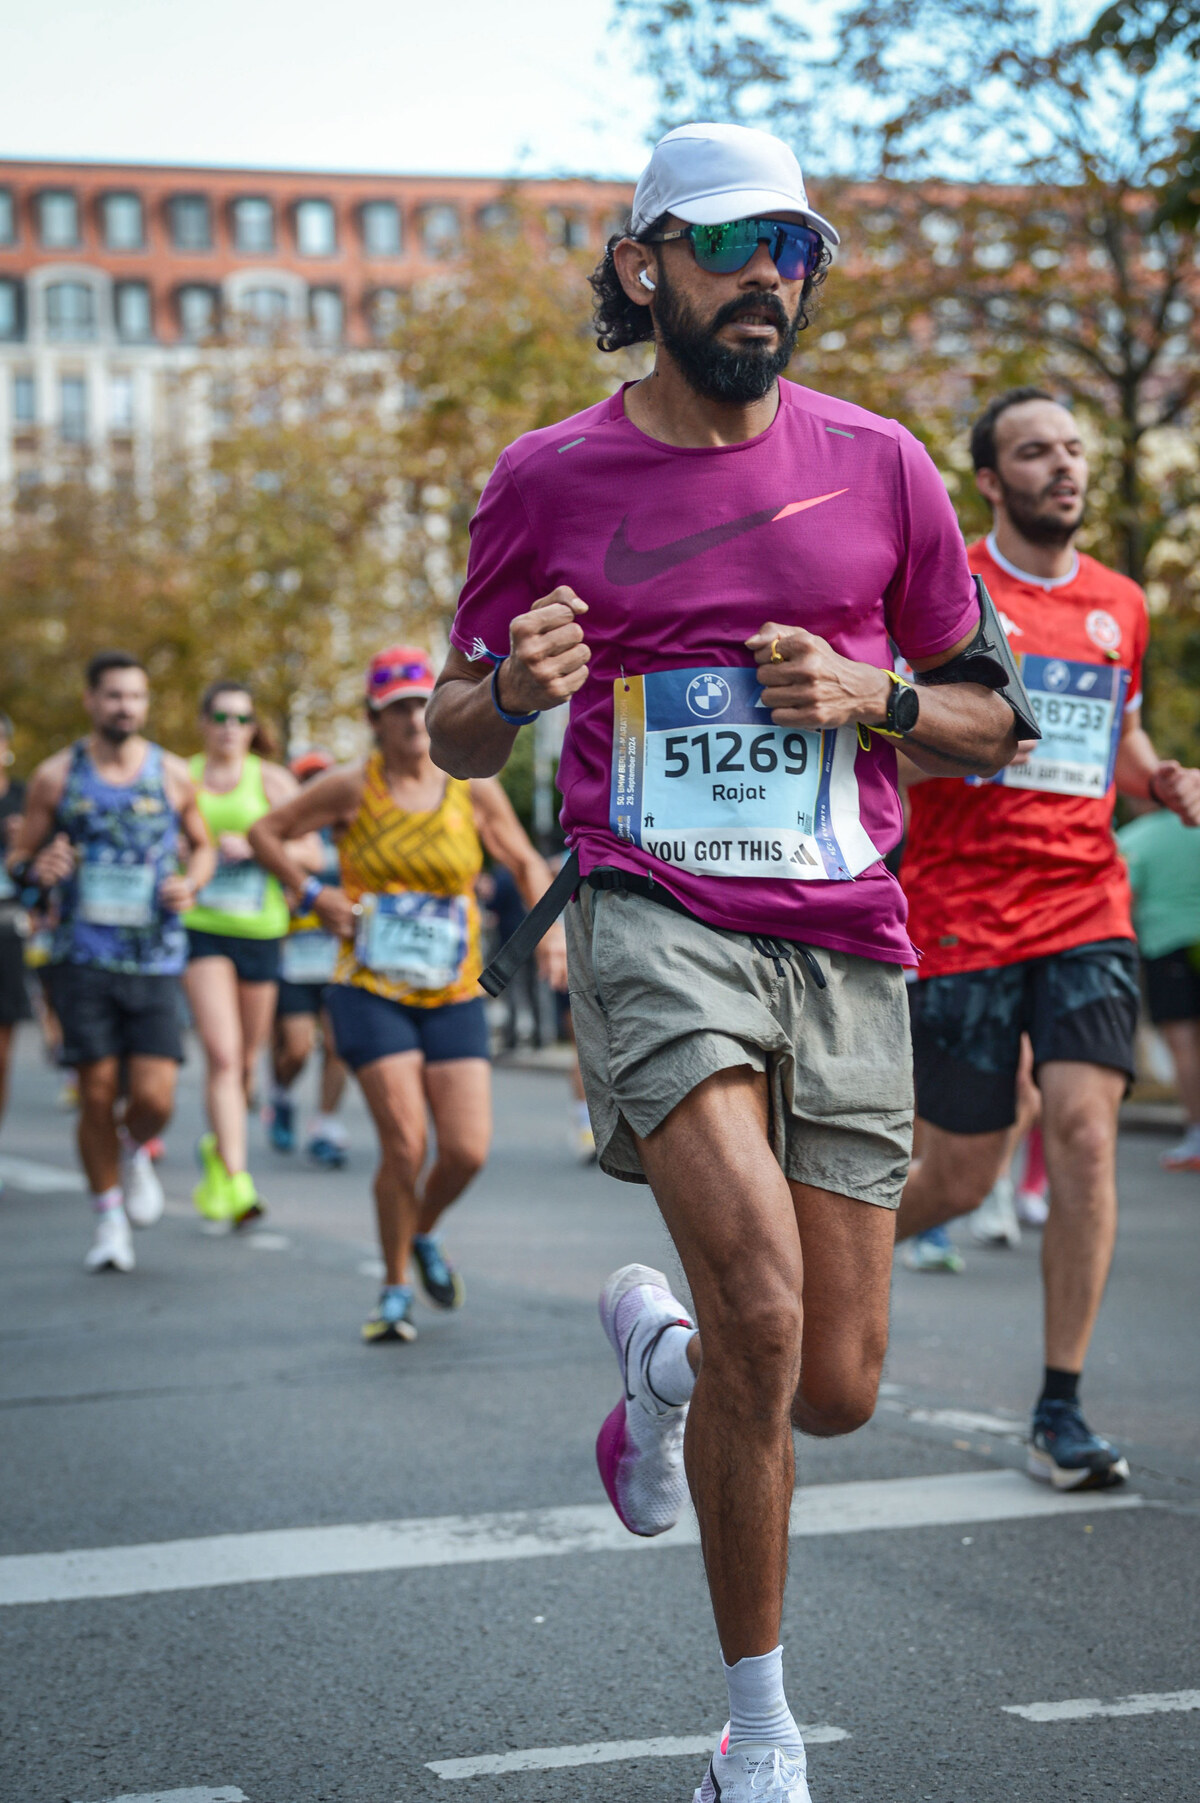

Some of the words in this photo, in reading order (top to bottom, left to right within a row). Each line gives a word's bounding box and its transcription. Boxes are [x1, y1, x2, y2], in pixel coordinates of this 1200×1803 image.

[692, 676, 725, 690] BMW
[628, 736, 637, 756] 2024
[664, 730, 808, 778] 51269
[617, 774, 626, 794] BMW
[627, 755, 637, 794] September
[616, 794, 625, 806] 50.
[626, 794, 635, 806] 29.
[712, 782, 766, 804] Rajat
[797, 810, 805, 827] H
[647, 841, 686, 861] YOU
[694, 840, 733, 861] GOT
[738, 840, 783, 861] THIS
